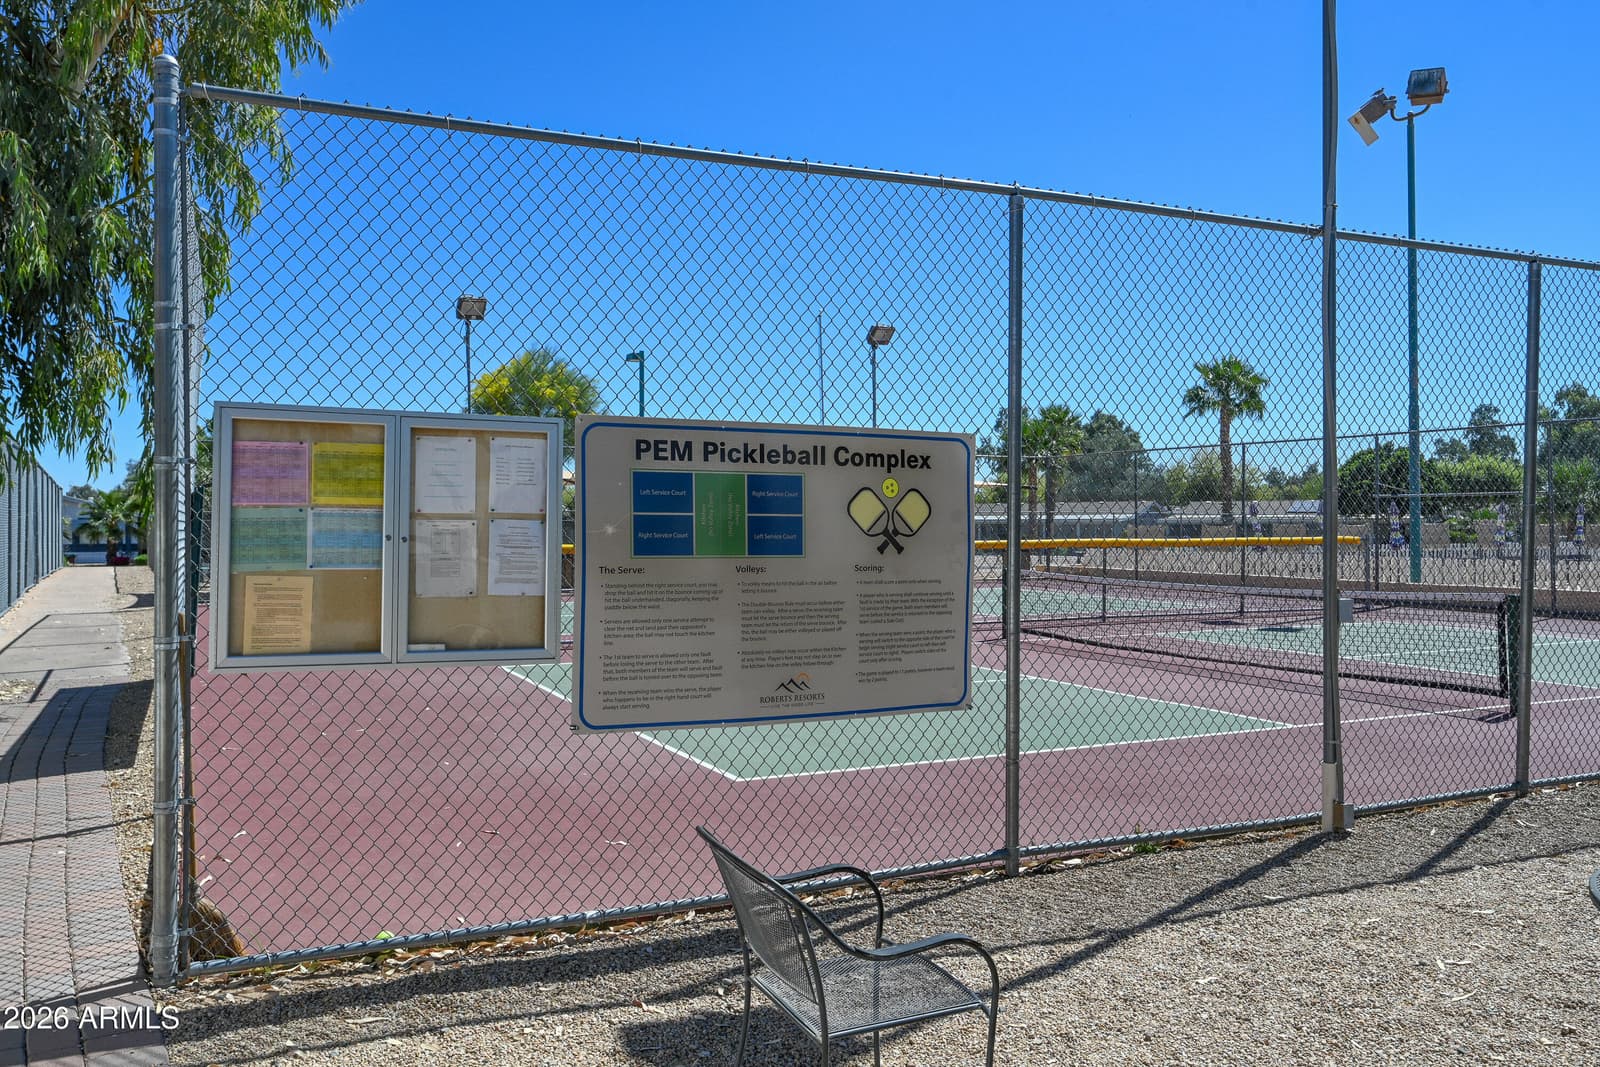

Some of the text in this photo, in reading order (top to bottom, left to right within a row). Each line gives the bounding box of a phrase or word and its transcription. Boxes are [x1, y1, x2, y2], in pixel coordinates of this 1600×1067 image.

[635, 439, 932, 473] PEM Pickleball Complex
[752, 490, 766, 498] Right
[638, 531, 652, 539] Right
[599, 566, 645, 574] The Serve:
[735, 565, 767, 575] Volleys:
[854, 564, 885, 574] Scoring:
[760, 692, 824, 704] ROBERTS RESORTS
